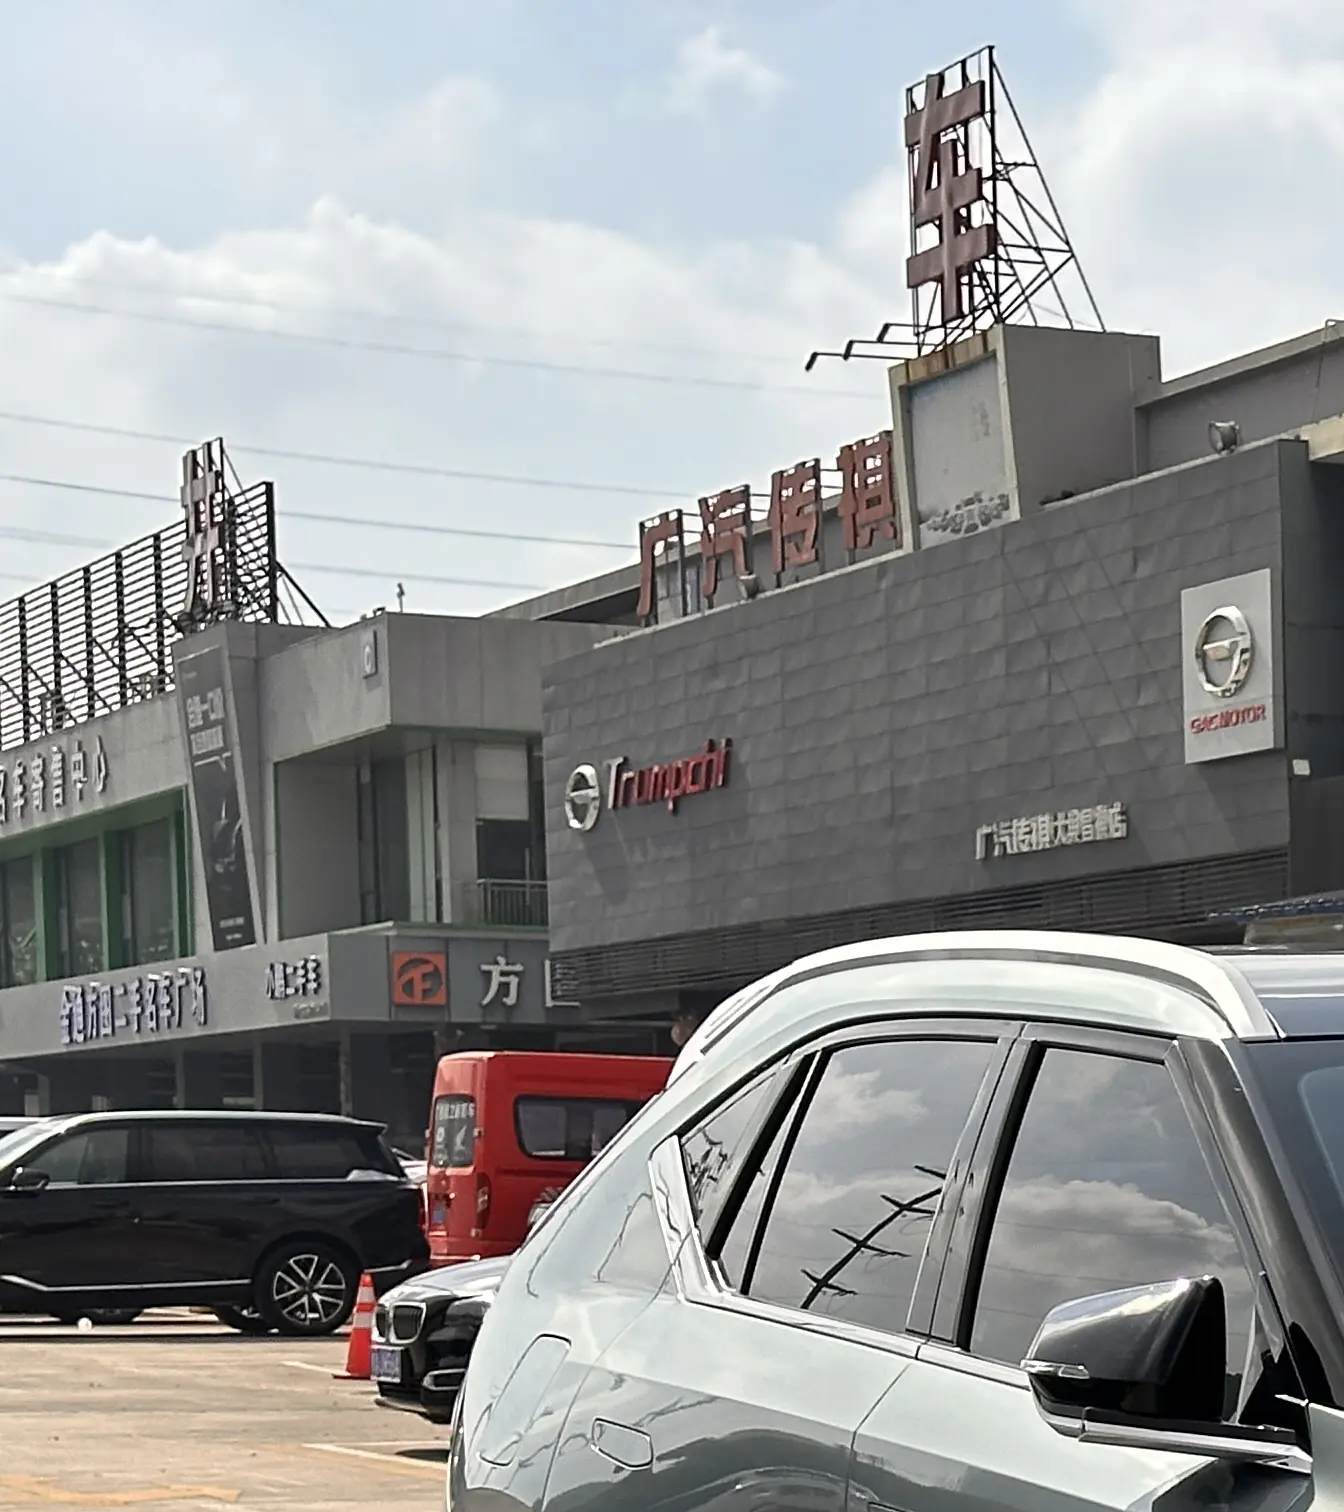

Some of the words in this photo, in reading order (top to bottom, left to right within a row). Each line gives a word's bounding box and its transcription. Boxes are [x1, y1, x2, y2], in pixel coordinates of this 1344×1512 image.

[637, 430, 896, 616] 广汽传祺
[603, 738, 730, 815] Trumpchi
